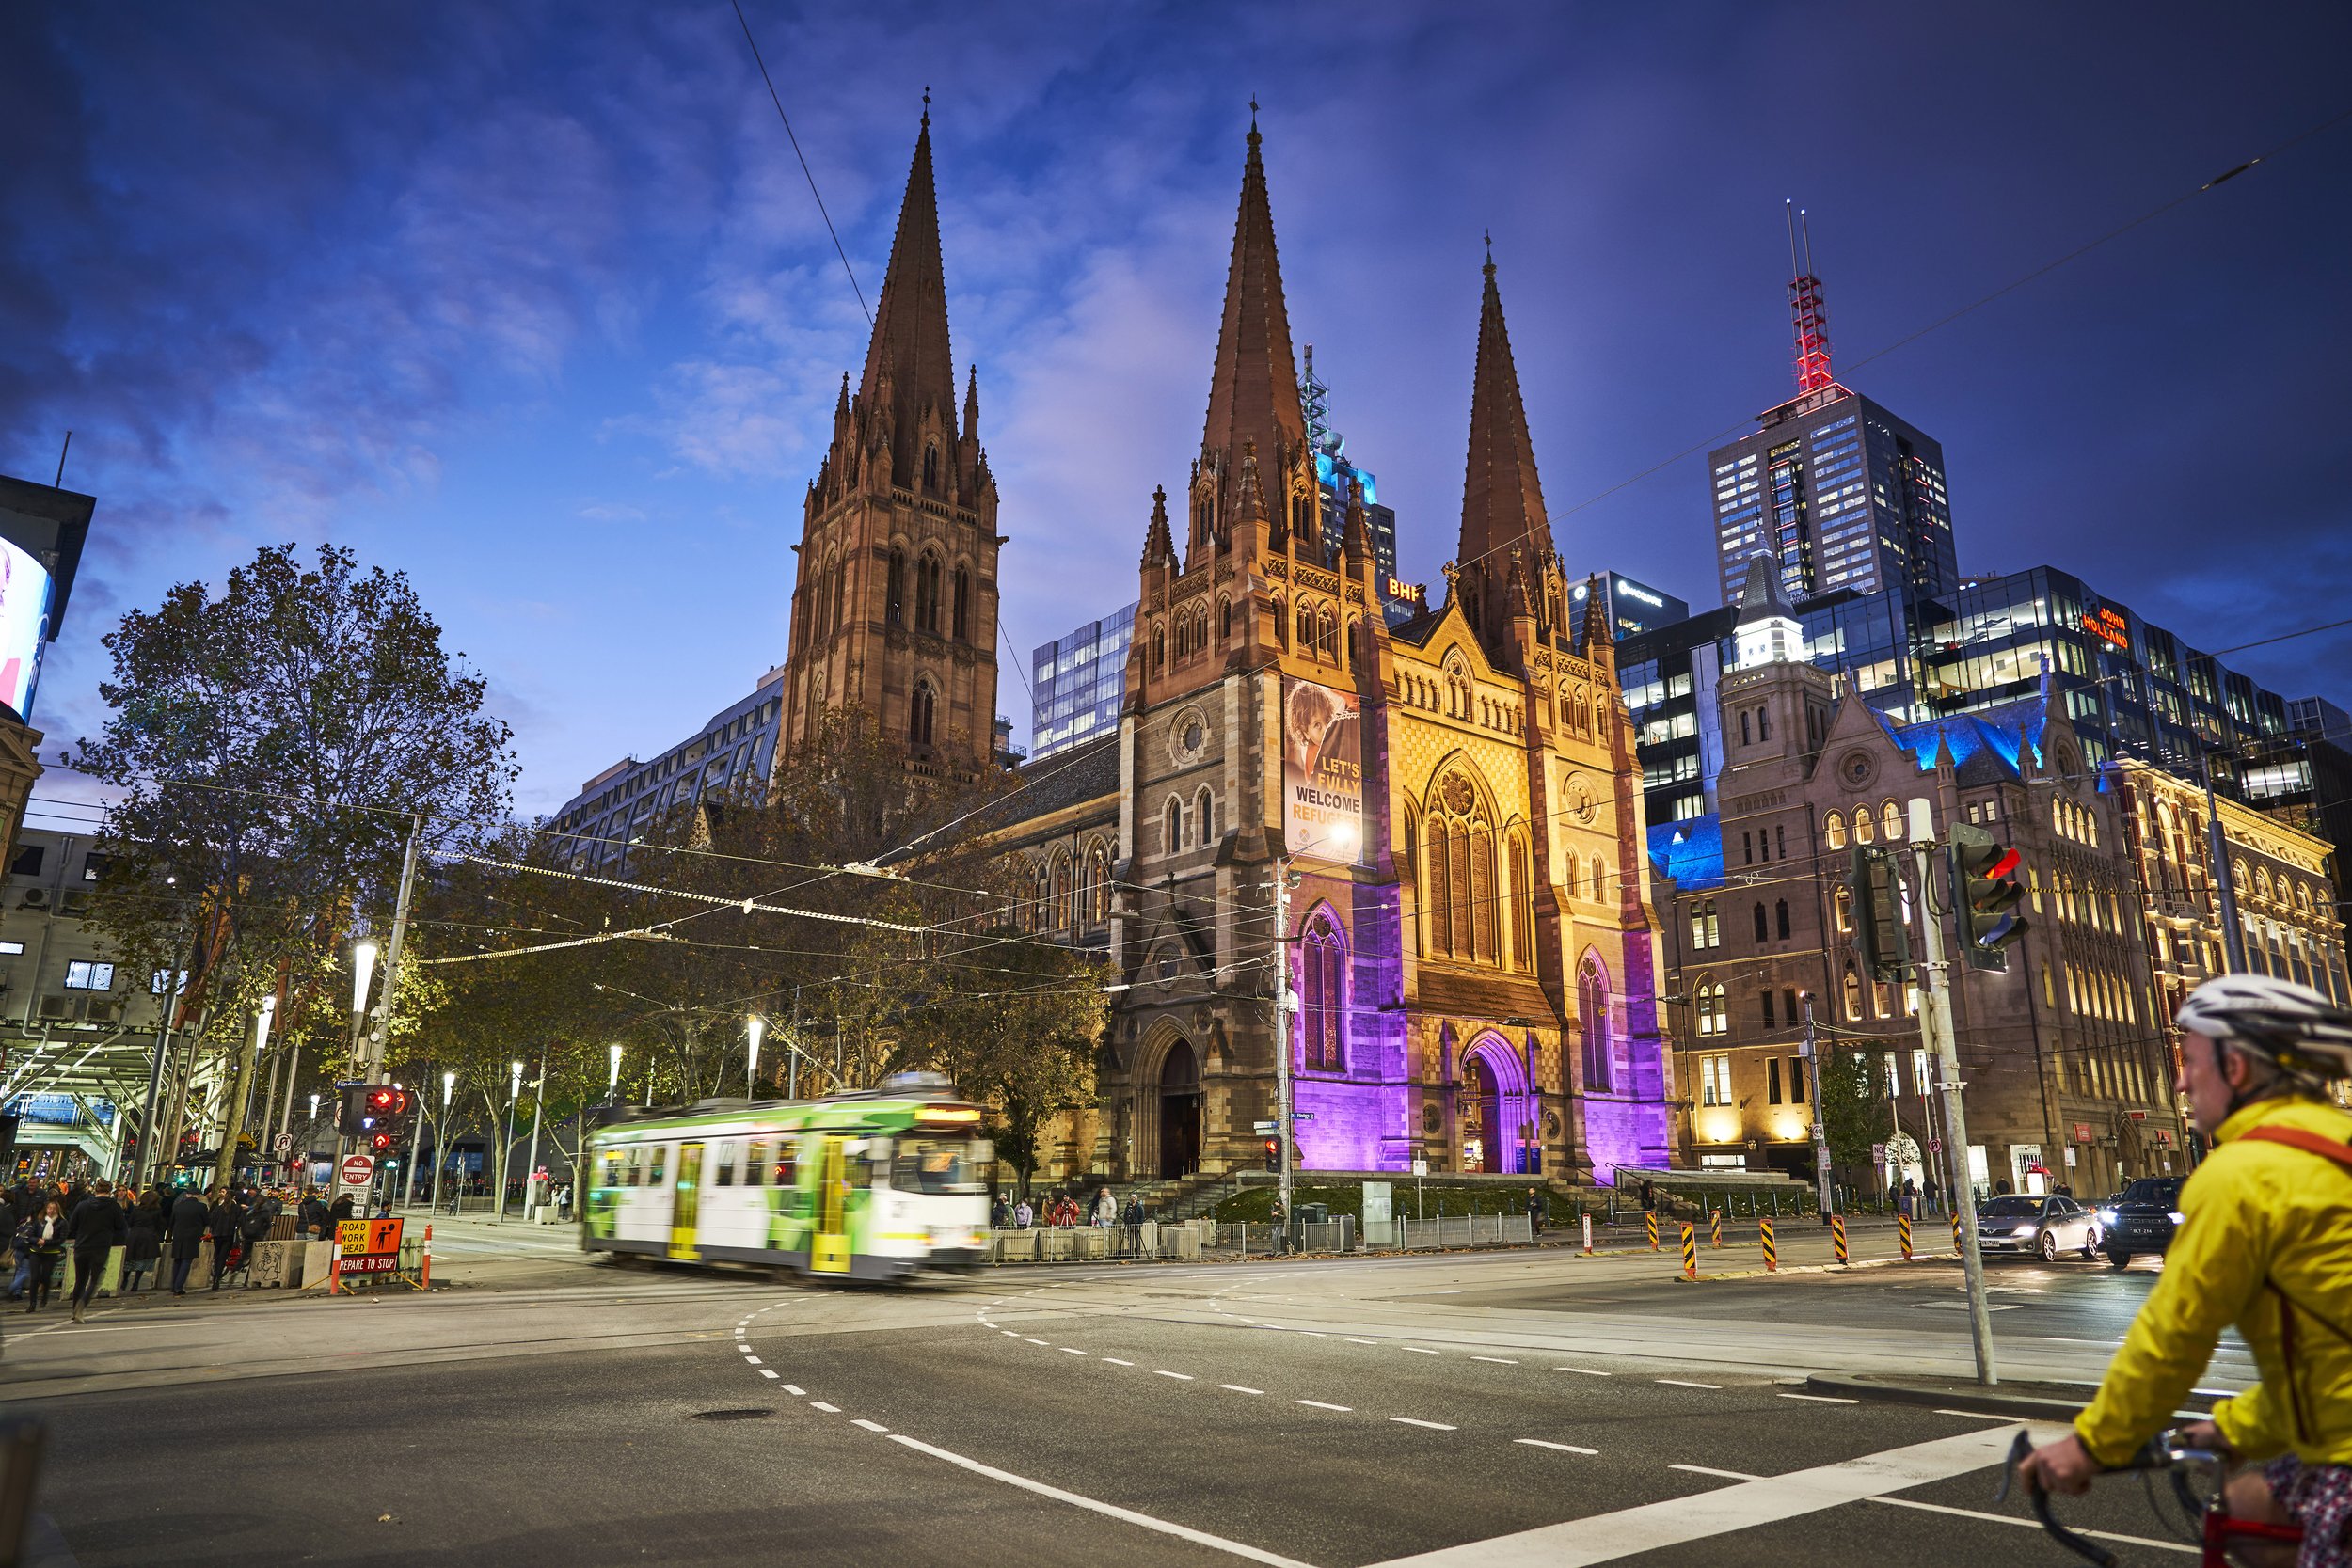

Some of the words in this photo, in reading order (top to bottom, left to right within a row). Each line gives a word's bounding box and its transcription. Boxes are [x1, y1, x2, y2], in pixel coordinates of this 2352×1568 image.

[2099, 607, 2126, 630] JOHN
[2082, 613, 2128, 649] HOLLAND
[1322, 756, 1359, 779] LET'S
[1317, 773, 1360, 795] FULLY
[1296, 786, 1360, 814] WELCOME
[342, 1223, 366, 1231] ROAD
[341, 1244, 365, 1253] HEAD
[367, 1259, 376, 1270] TO
[377, 1258, 395, 1269] STOP
